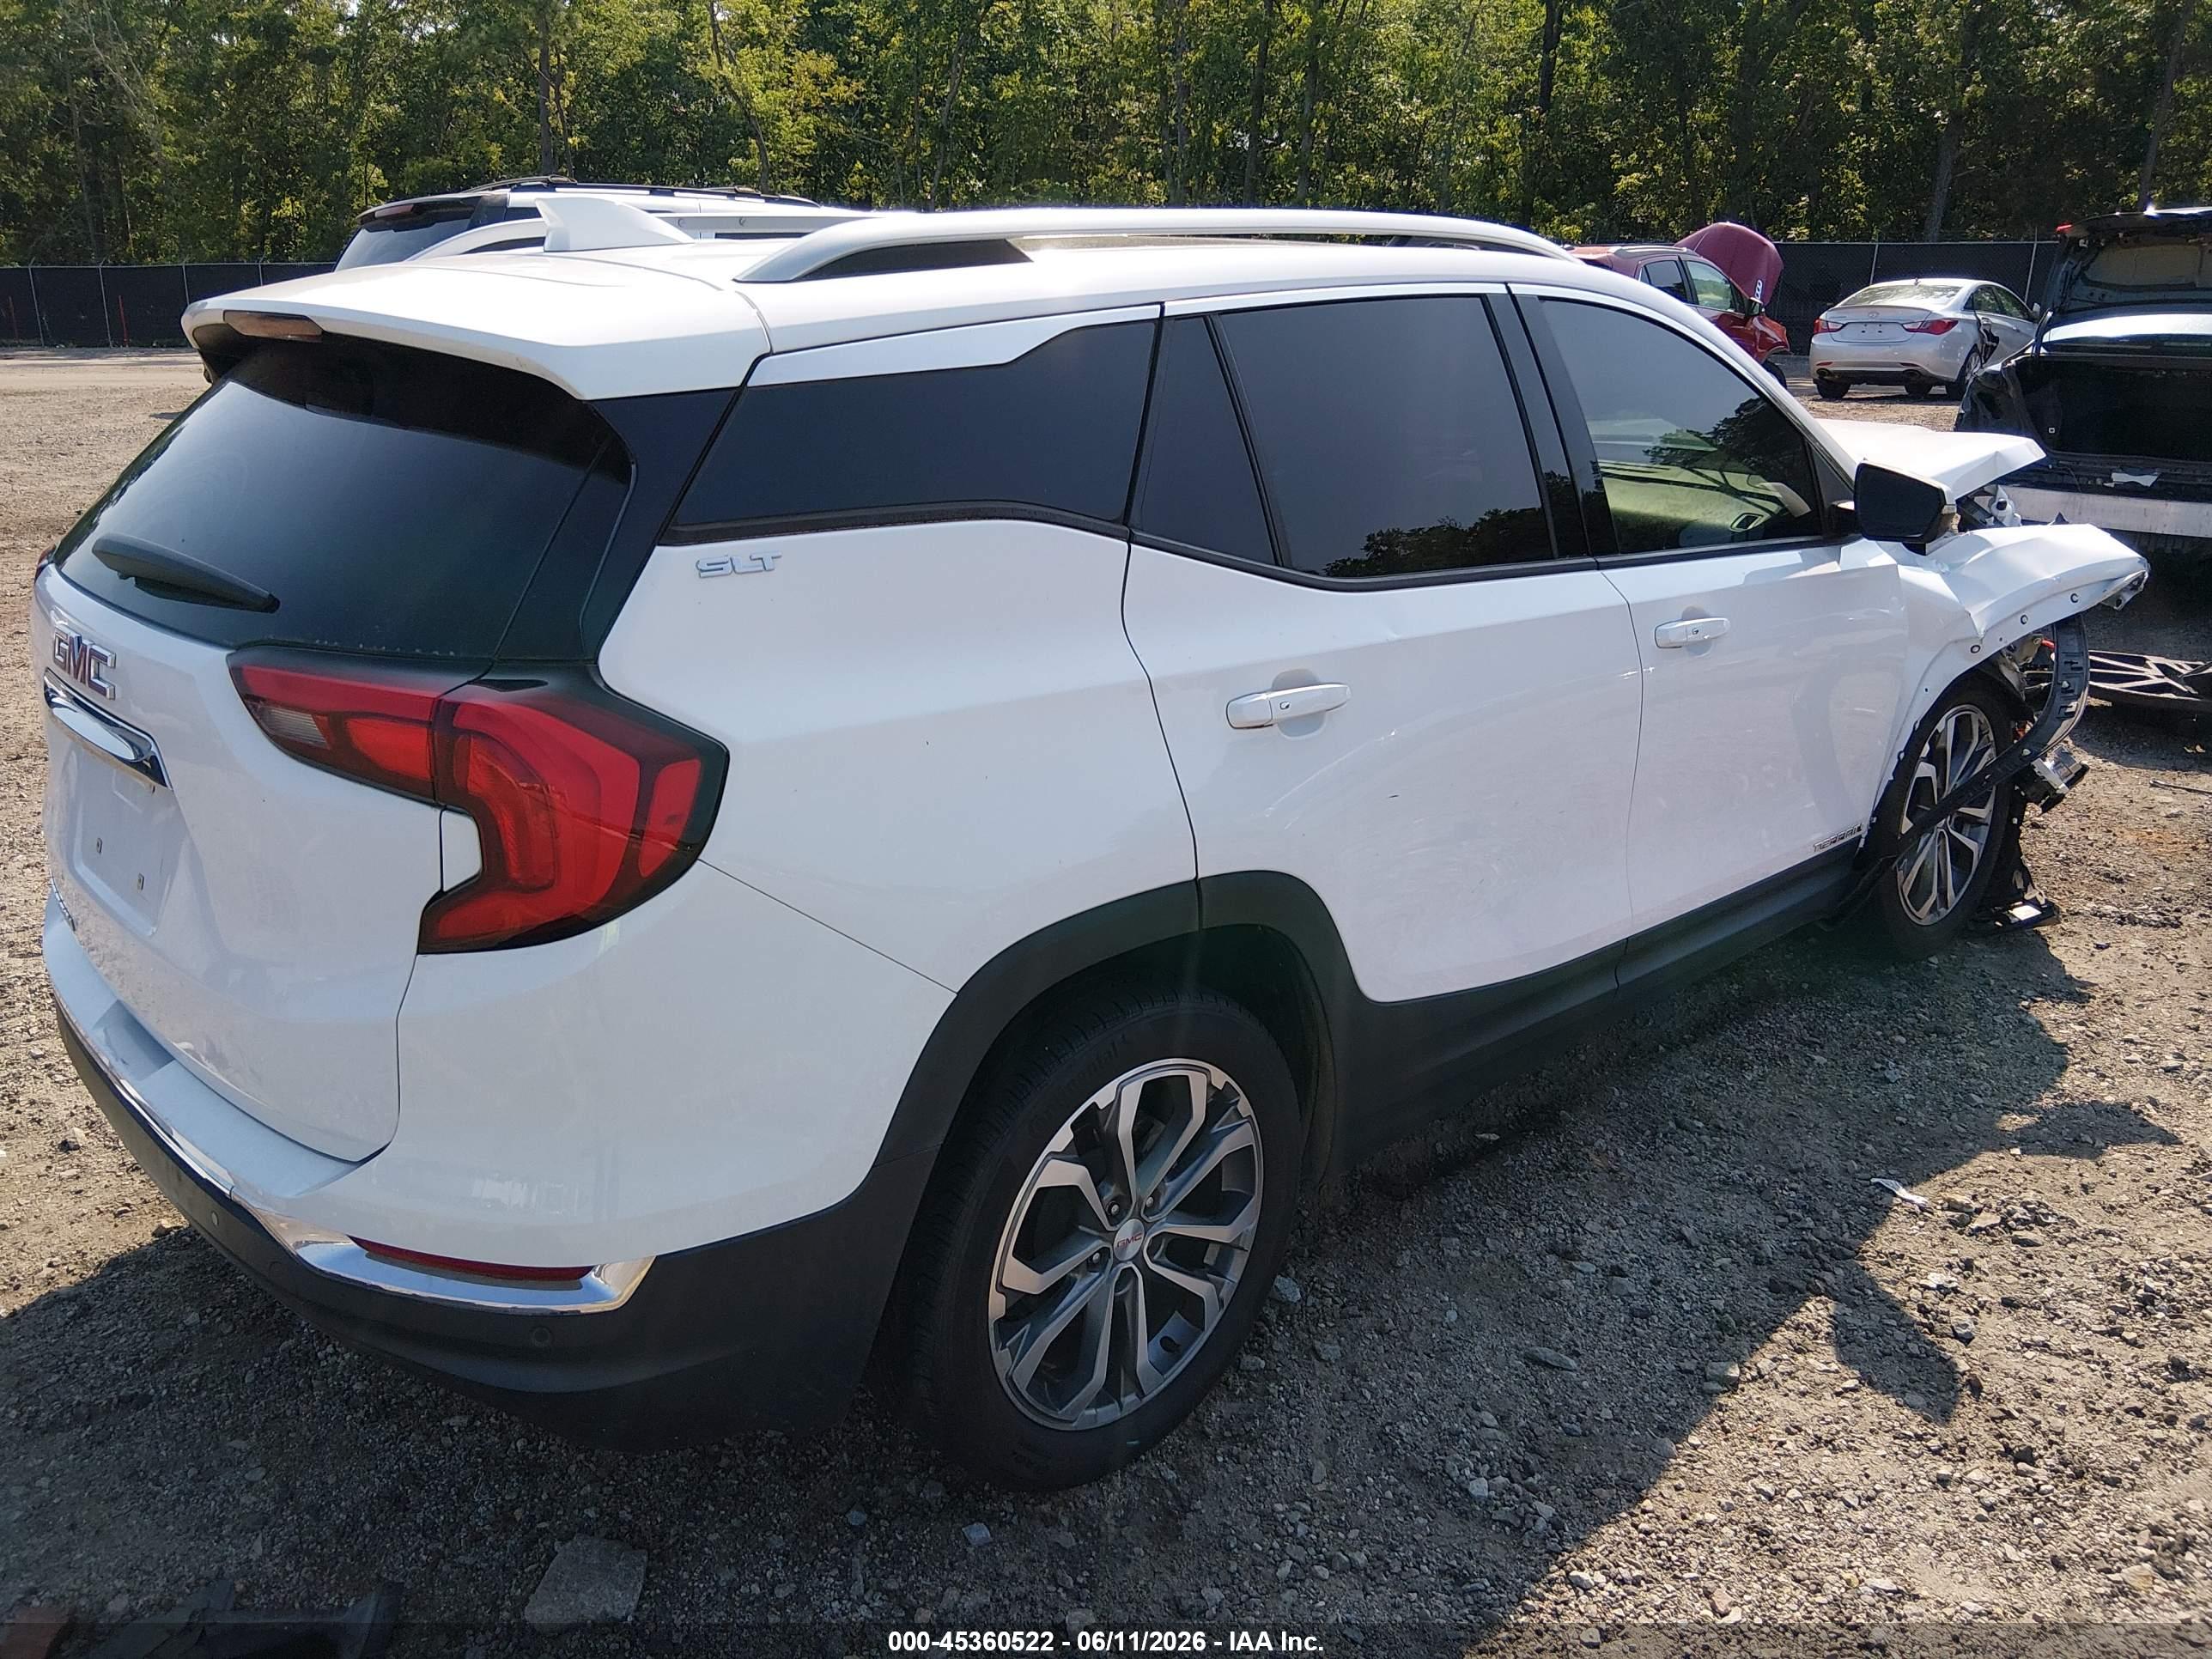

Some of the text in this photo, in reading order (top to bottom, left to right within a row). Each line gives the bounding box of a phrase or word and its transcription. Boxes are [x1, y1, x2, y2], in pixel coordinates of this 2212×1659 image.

[696, 550, 782, 579] SLT
[53, 625, 117, 701] GMC
[1116, 1232, 1143, 1249] GMC
